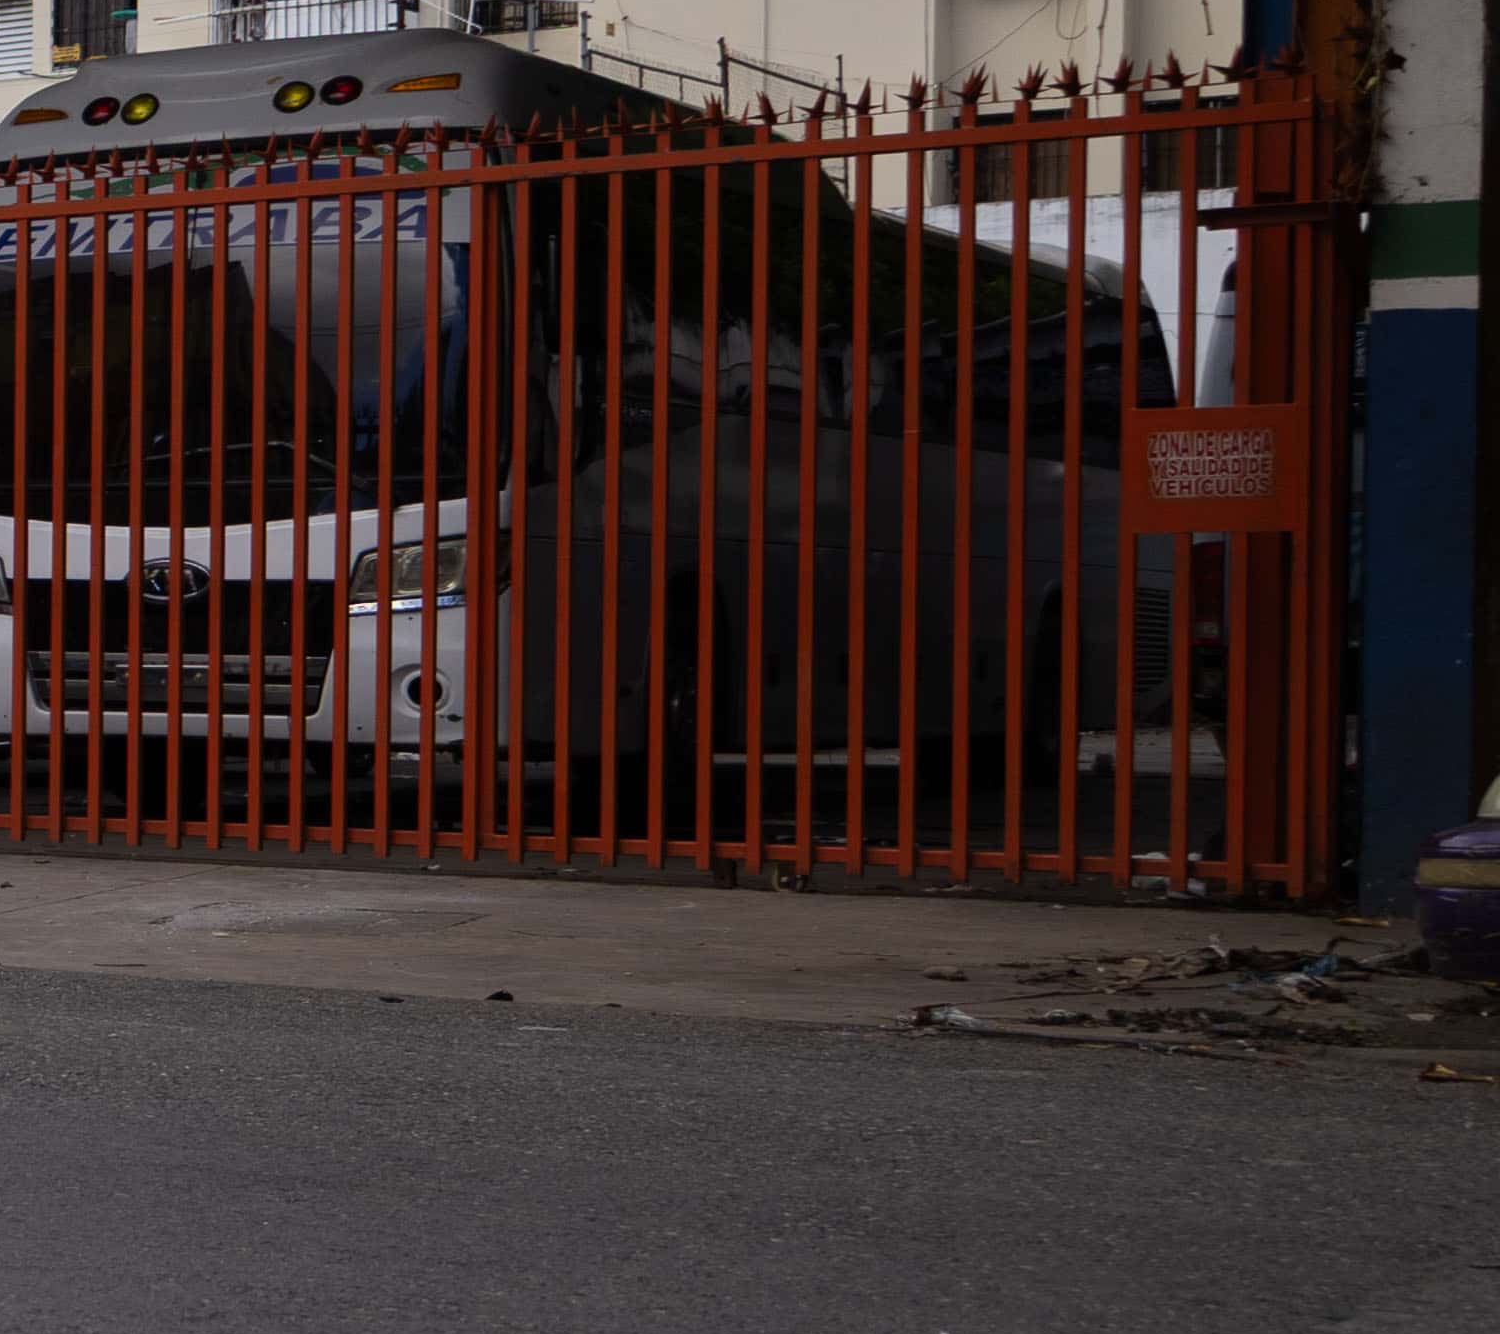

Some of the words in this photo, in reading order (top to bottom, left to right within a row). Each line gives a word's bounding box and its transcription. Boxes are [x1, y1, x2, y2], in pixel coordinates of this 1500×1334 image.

[1148, 432, 1189, 458] ZONA
[1194, 431, 1215, 457] DE
[1149, 476, 1271, 497] VEHICULOS
